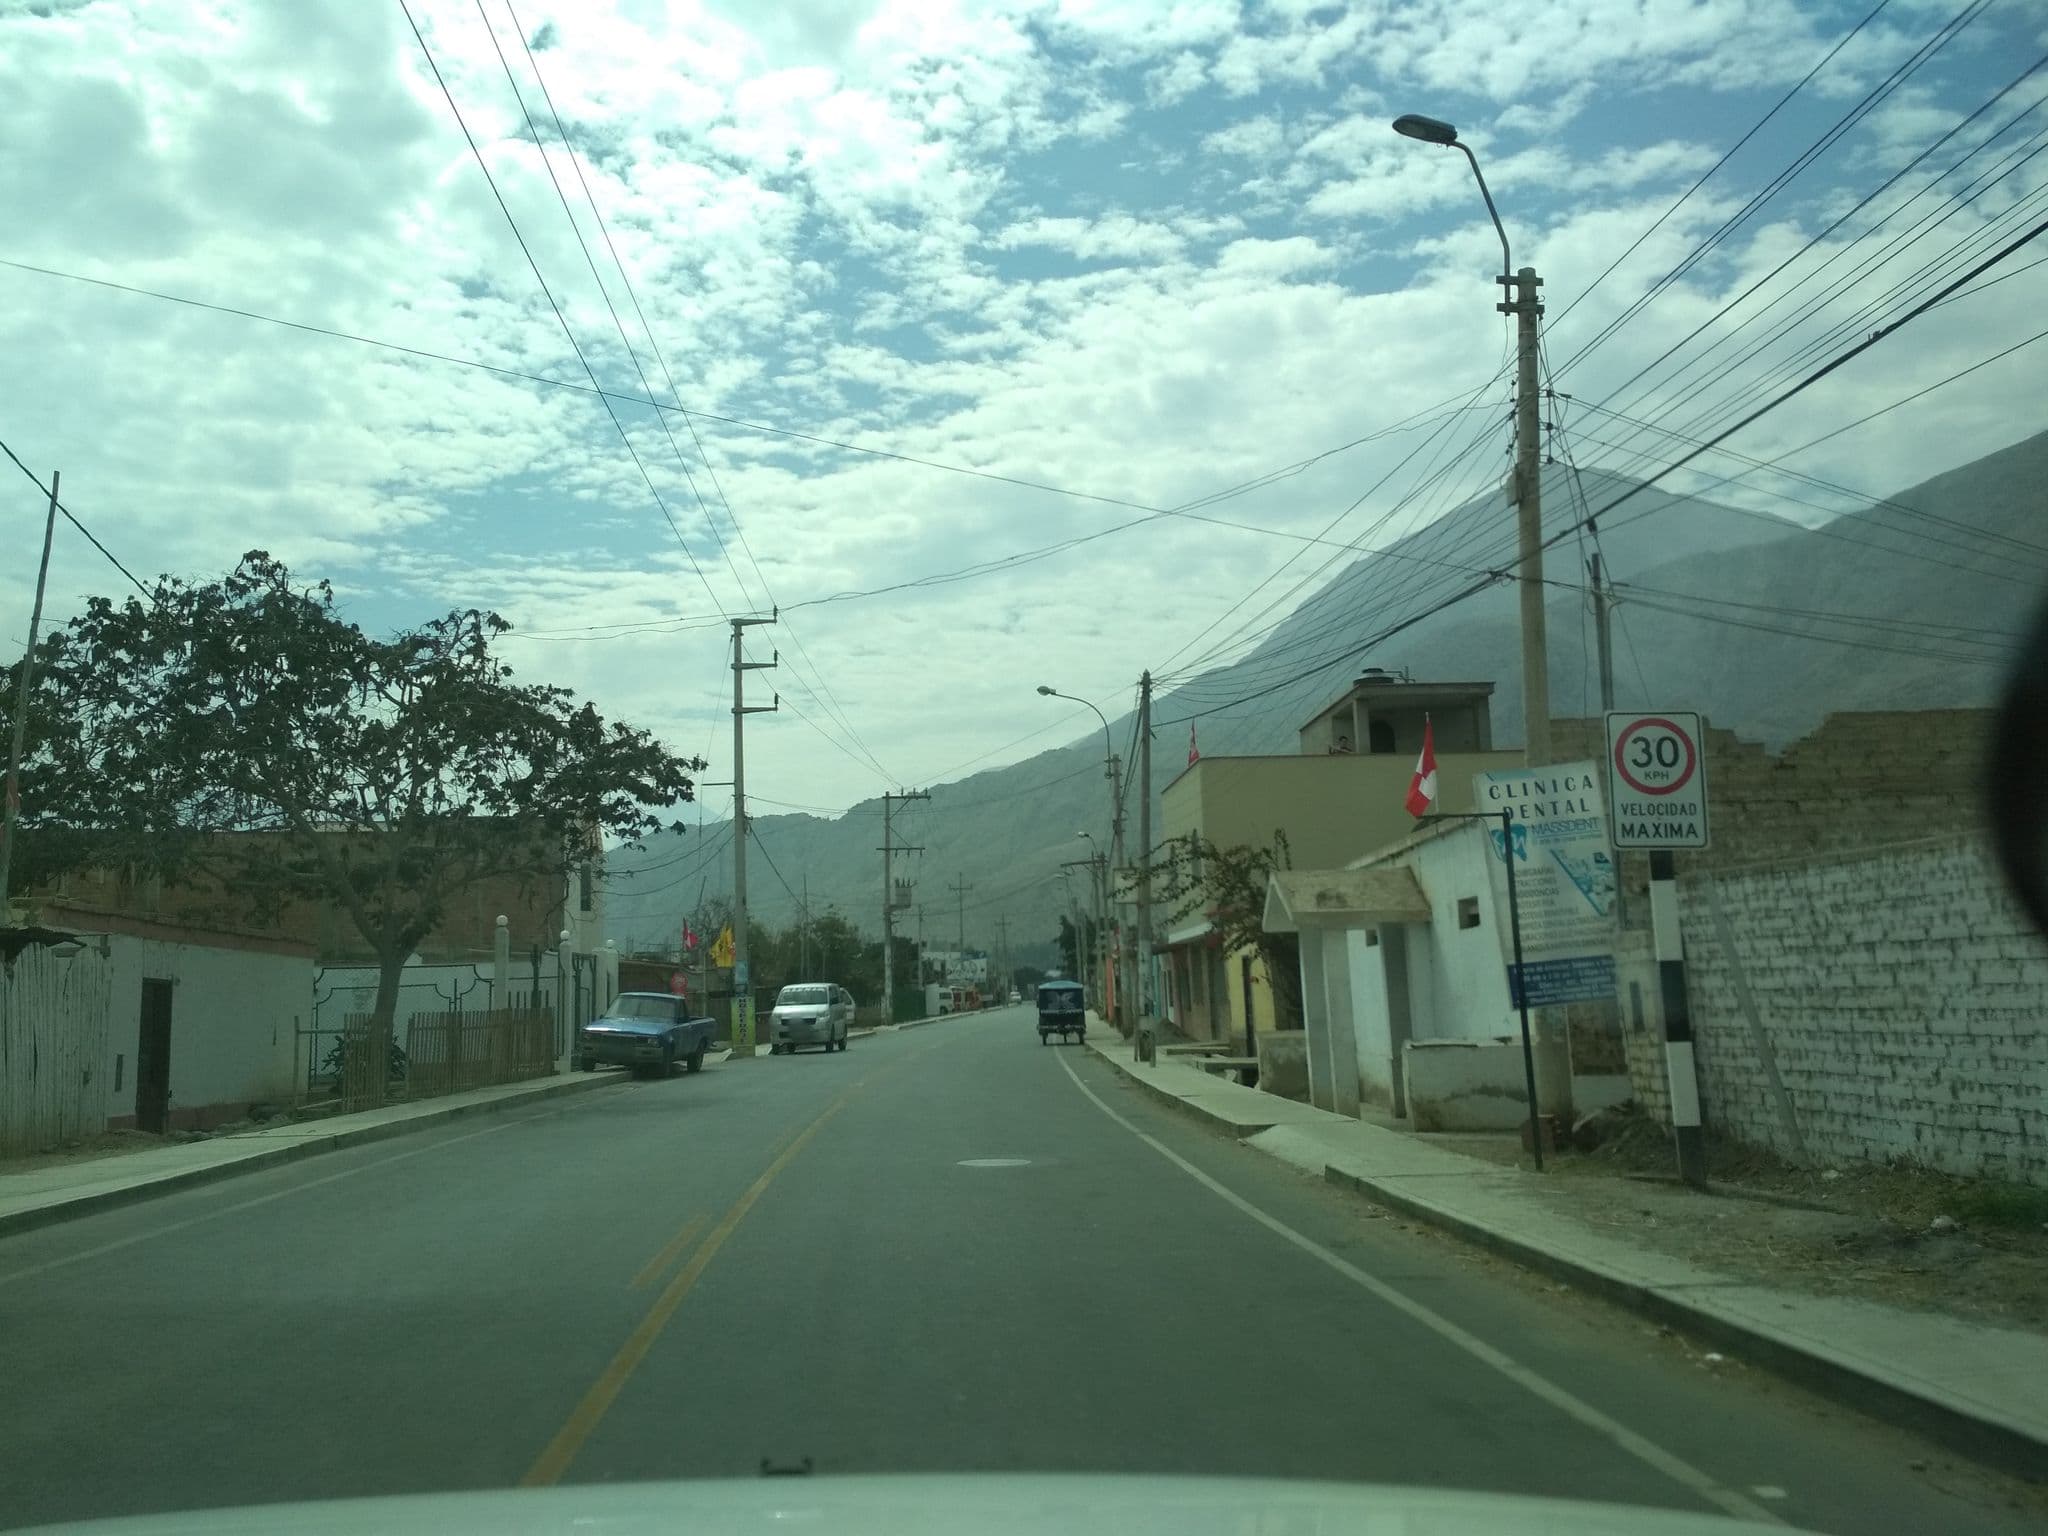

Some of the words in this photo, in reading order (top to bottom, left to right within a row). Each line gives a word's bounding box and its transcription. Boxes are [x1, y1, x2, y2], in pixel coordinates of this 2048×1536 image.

[1631, 736, 1679, 768] 30
[1644, 770, 1669, 780] KPH
[1489, 775, 1593, 800] CLINICA
[1503, 798, 1591, 820] DENTAL
[1621, 803, 1697, 816] VELOCIDAD
[1531, 816, 1600, 835] MASSDENT
[1621, 823, 1699, 839] MAXIMA
